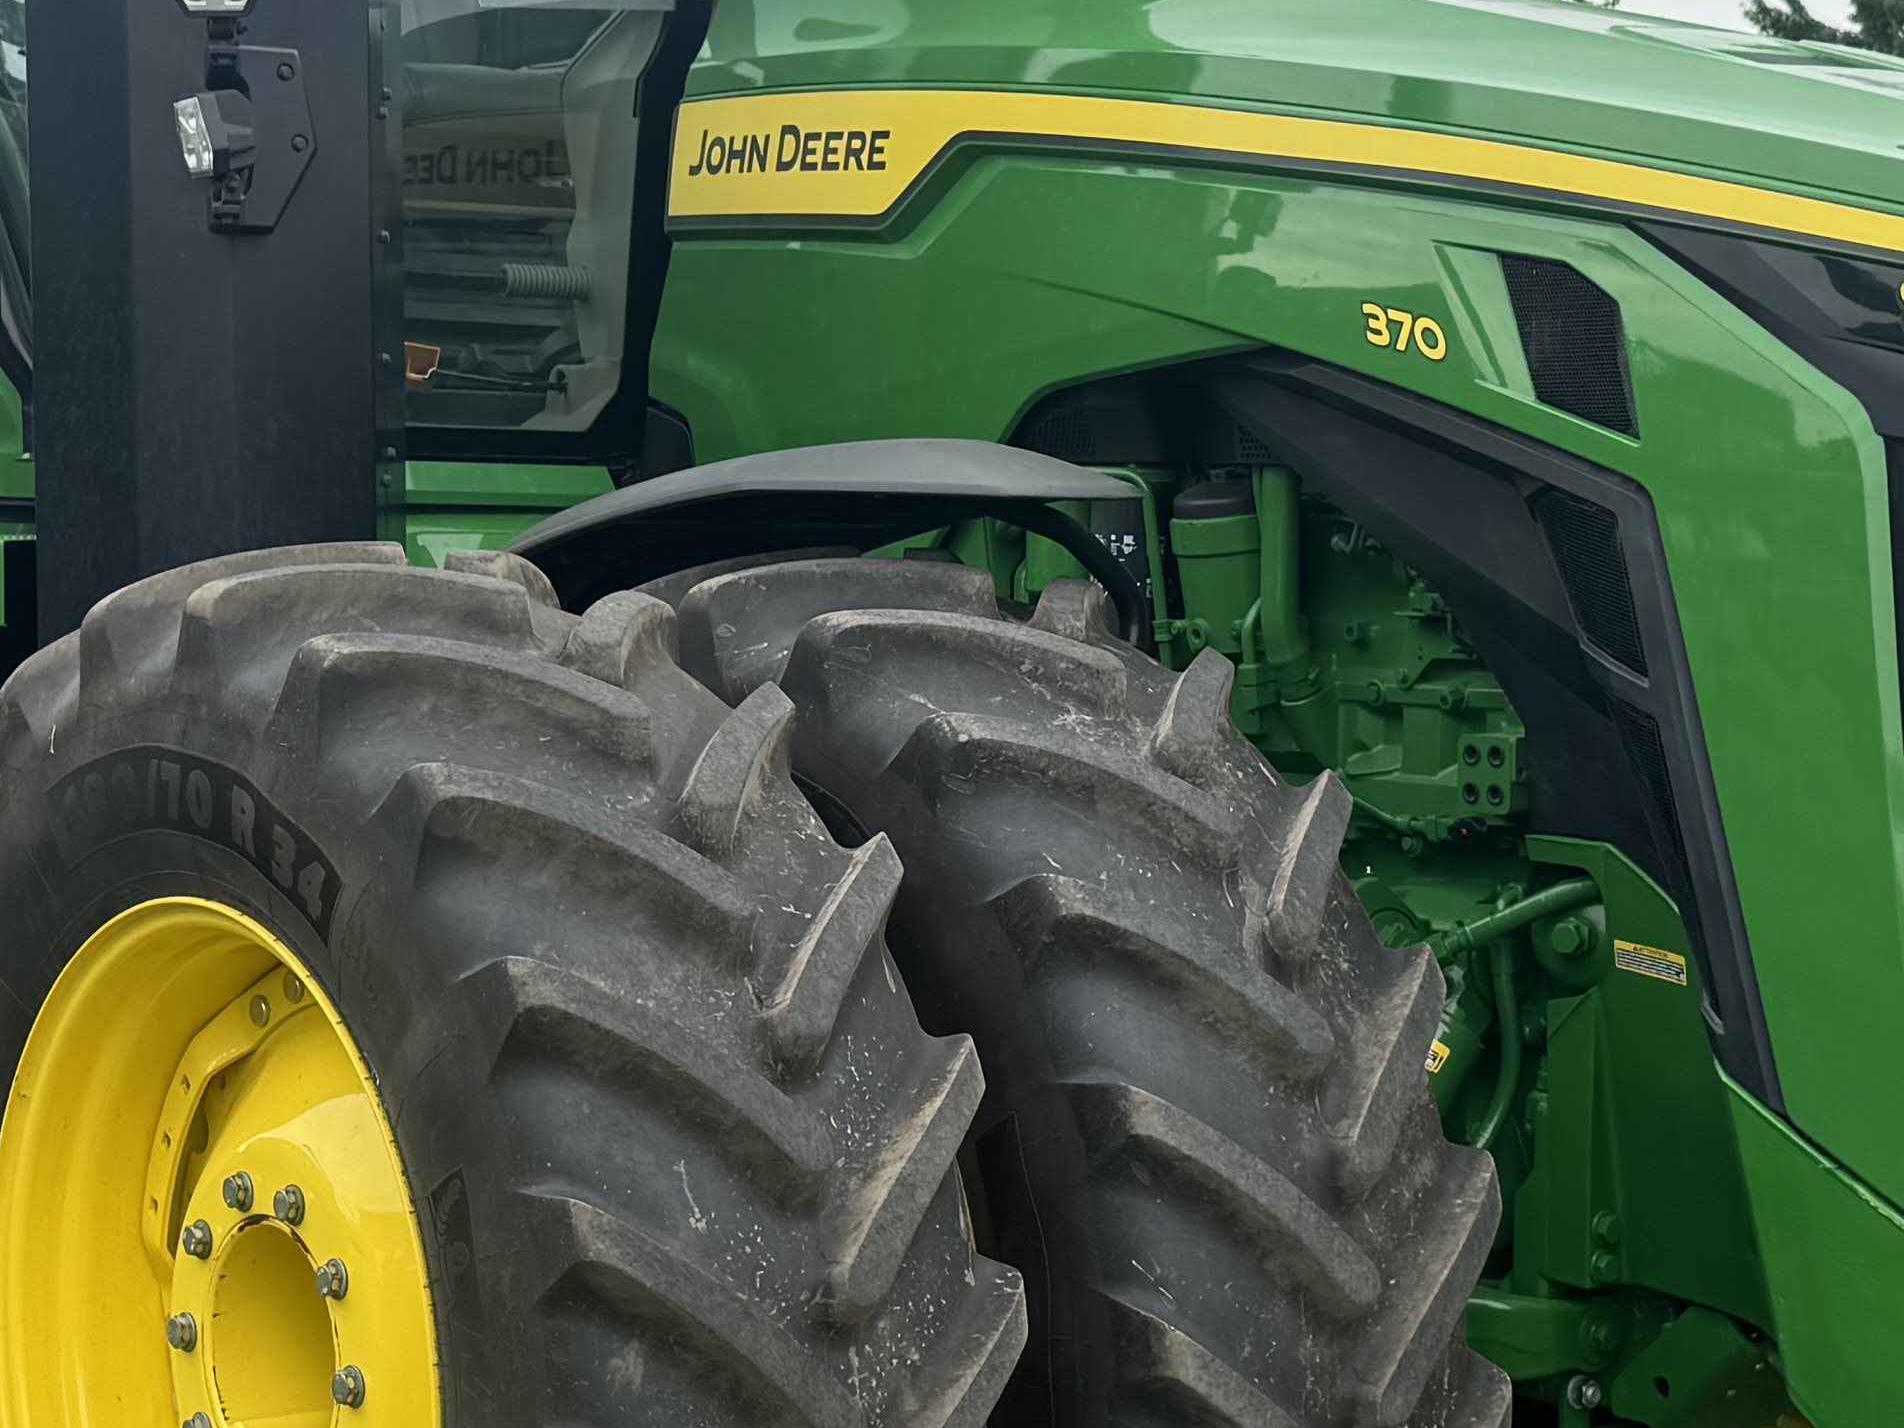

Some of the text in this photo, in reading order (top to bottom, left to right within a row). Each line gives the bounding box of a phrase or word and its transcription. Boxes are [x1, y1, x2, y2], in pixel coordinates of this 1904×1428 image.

[688, 124, 892, 177] JOHN DEERE
[1360, 302, 1448, 361] 370
[230, 784, 257, 859] R
[271, 823, 327, 920] 34
